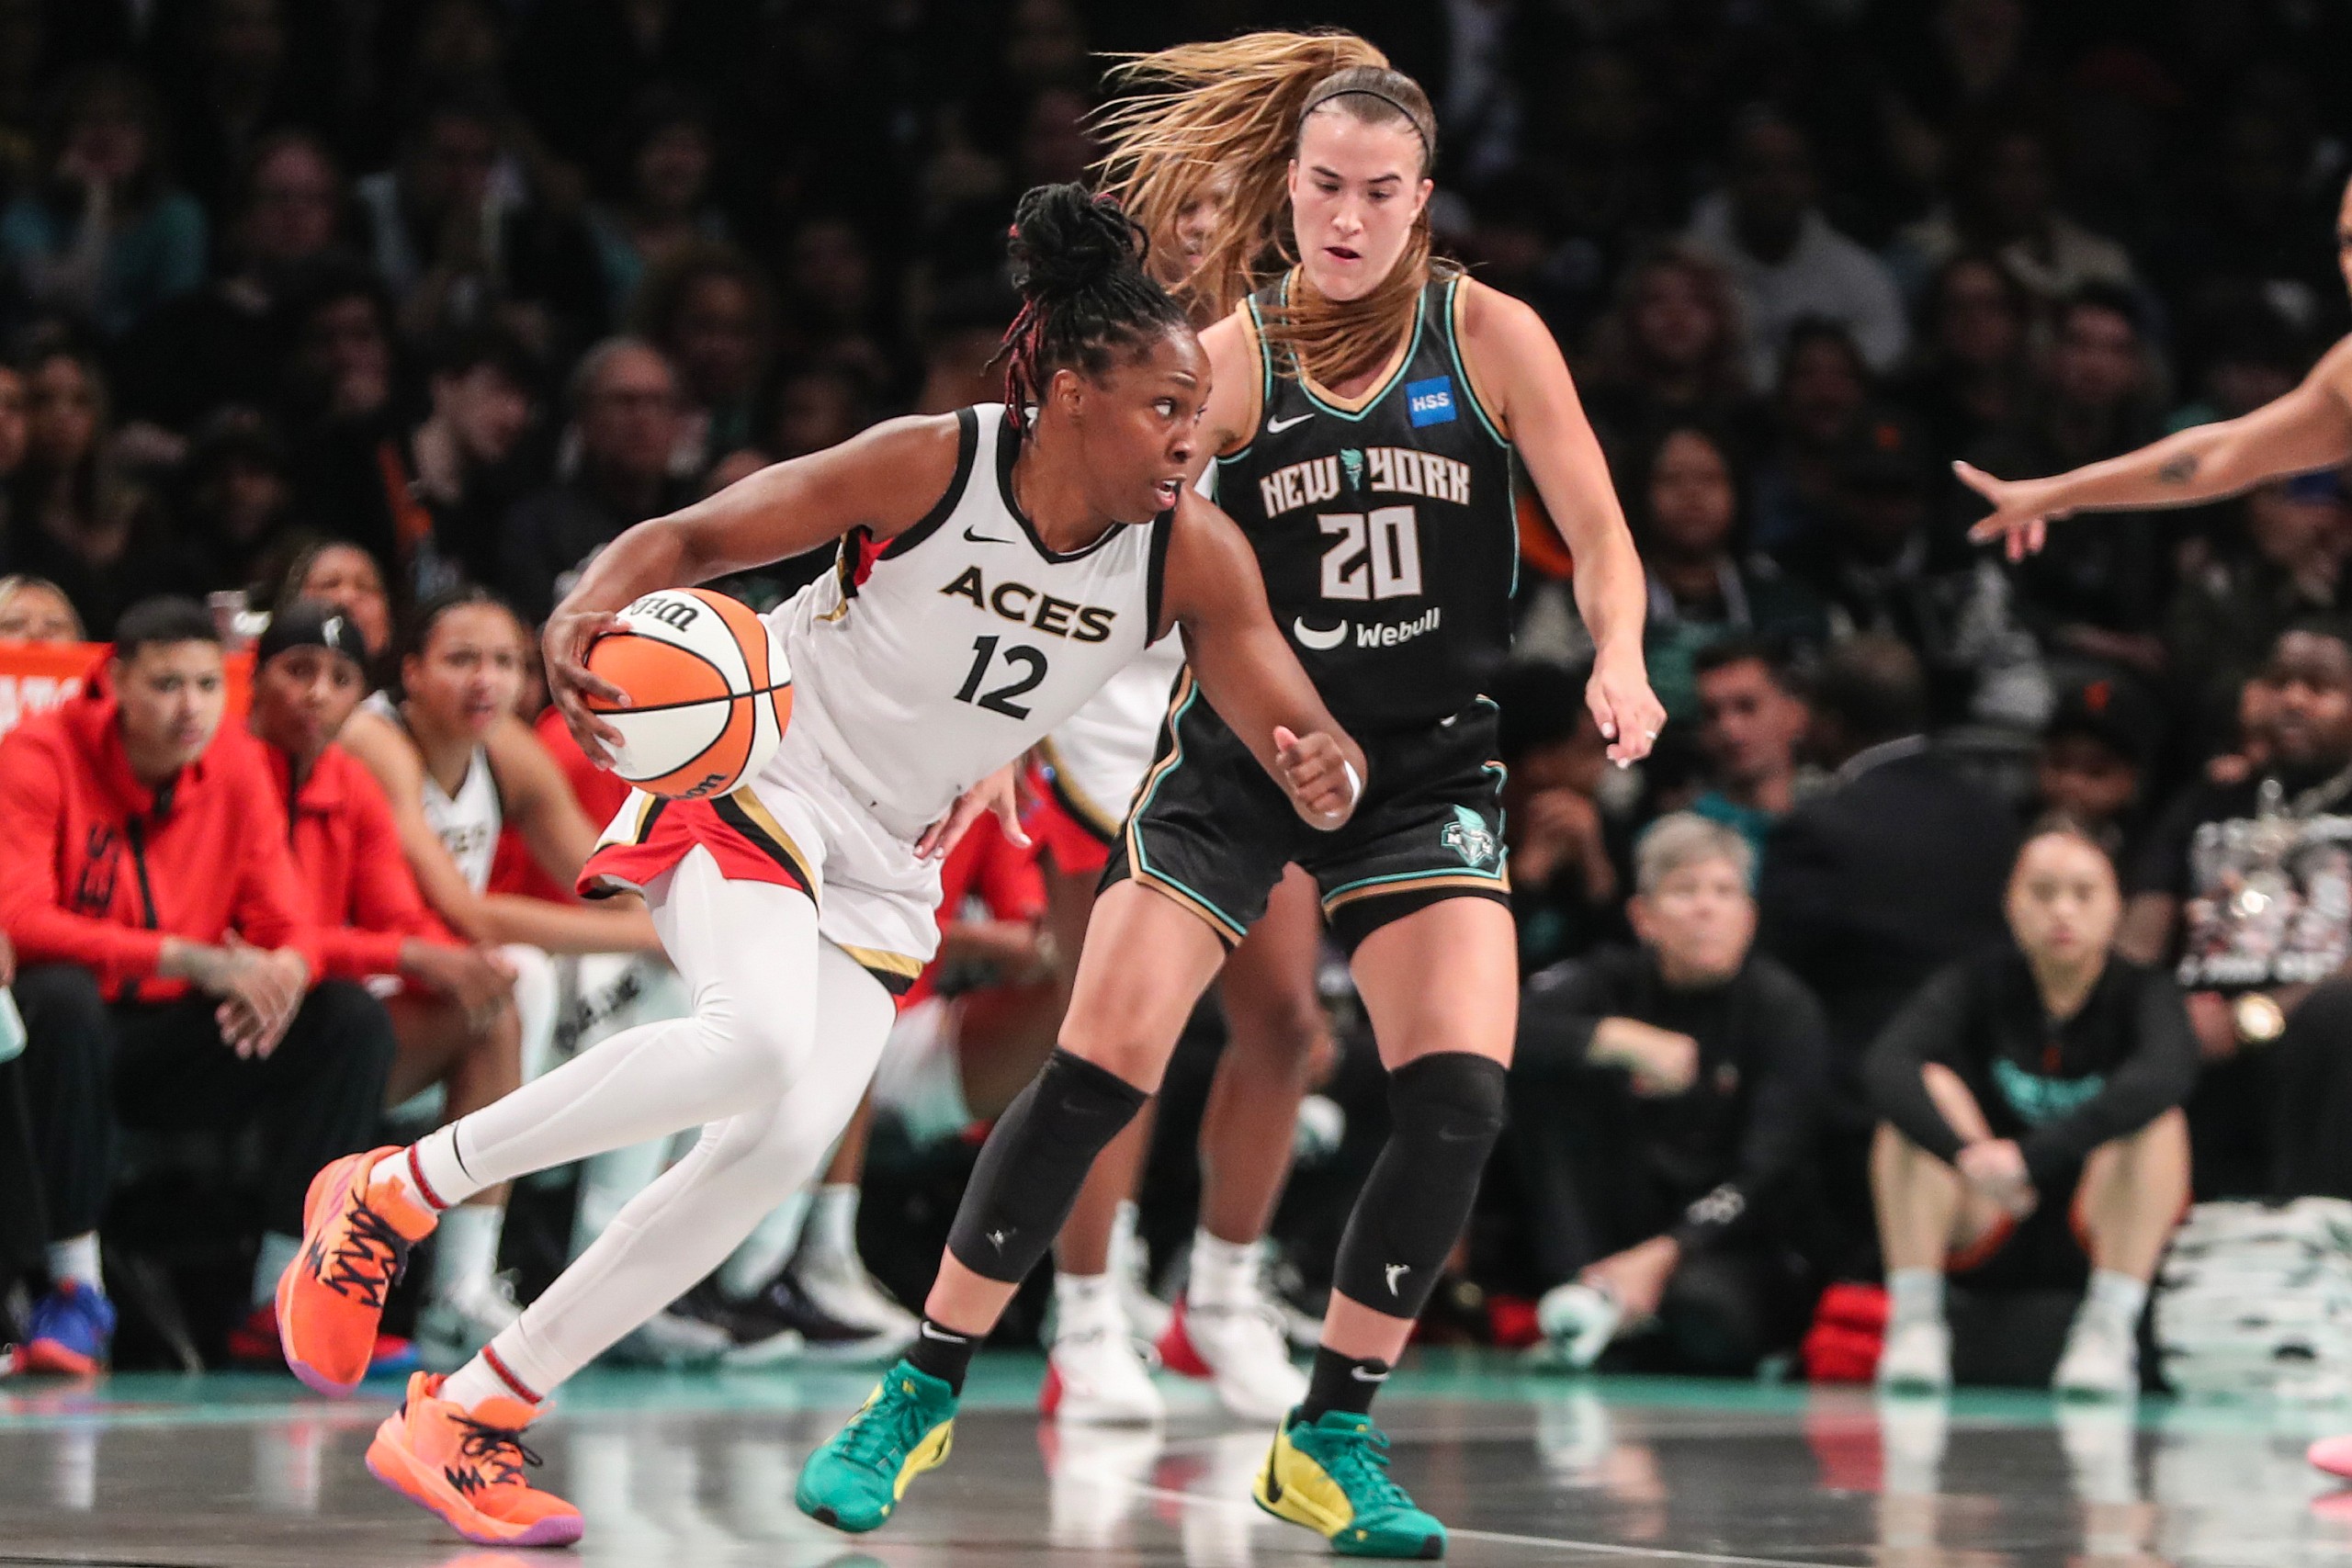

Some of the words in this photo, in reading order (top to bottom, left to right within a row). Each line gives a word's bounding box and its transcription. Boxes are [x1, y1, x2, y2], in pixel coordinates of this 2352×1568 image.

[1412, 392, 1450, 412] HSS
[1260, 455, 1340, 519] NEW
[1365, 446, 1470, 505] YORK
[1317, 505, 1423, 601] 20
[629, 597, 698, 633] Wil
[939, 564, 1117, 643] ACES
[1355, 606, 1442, 649] Webull
[954, 635, 1048, 721] 12
